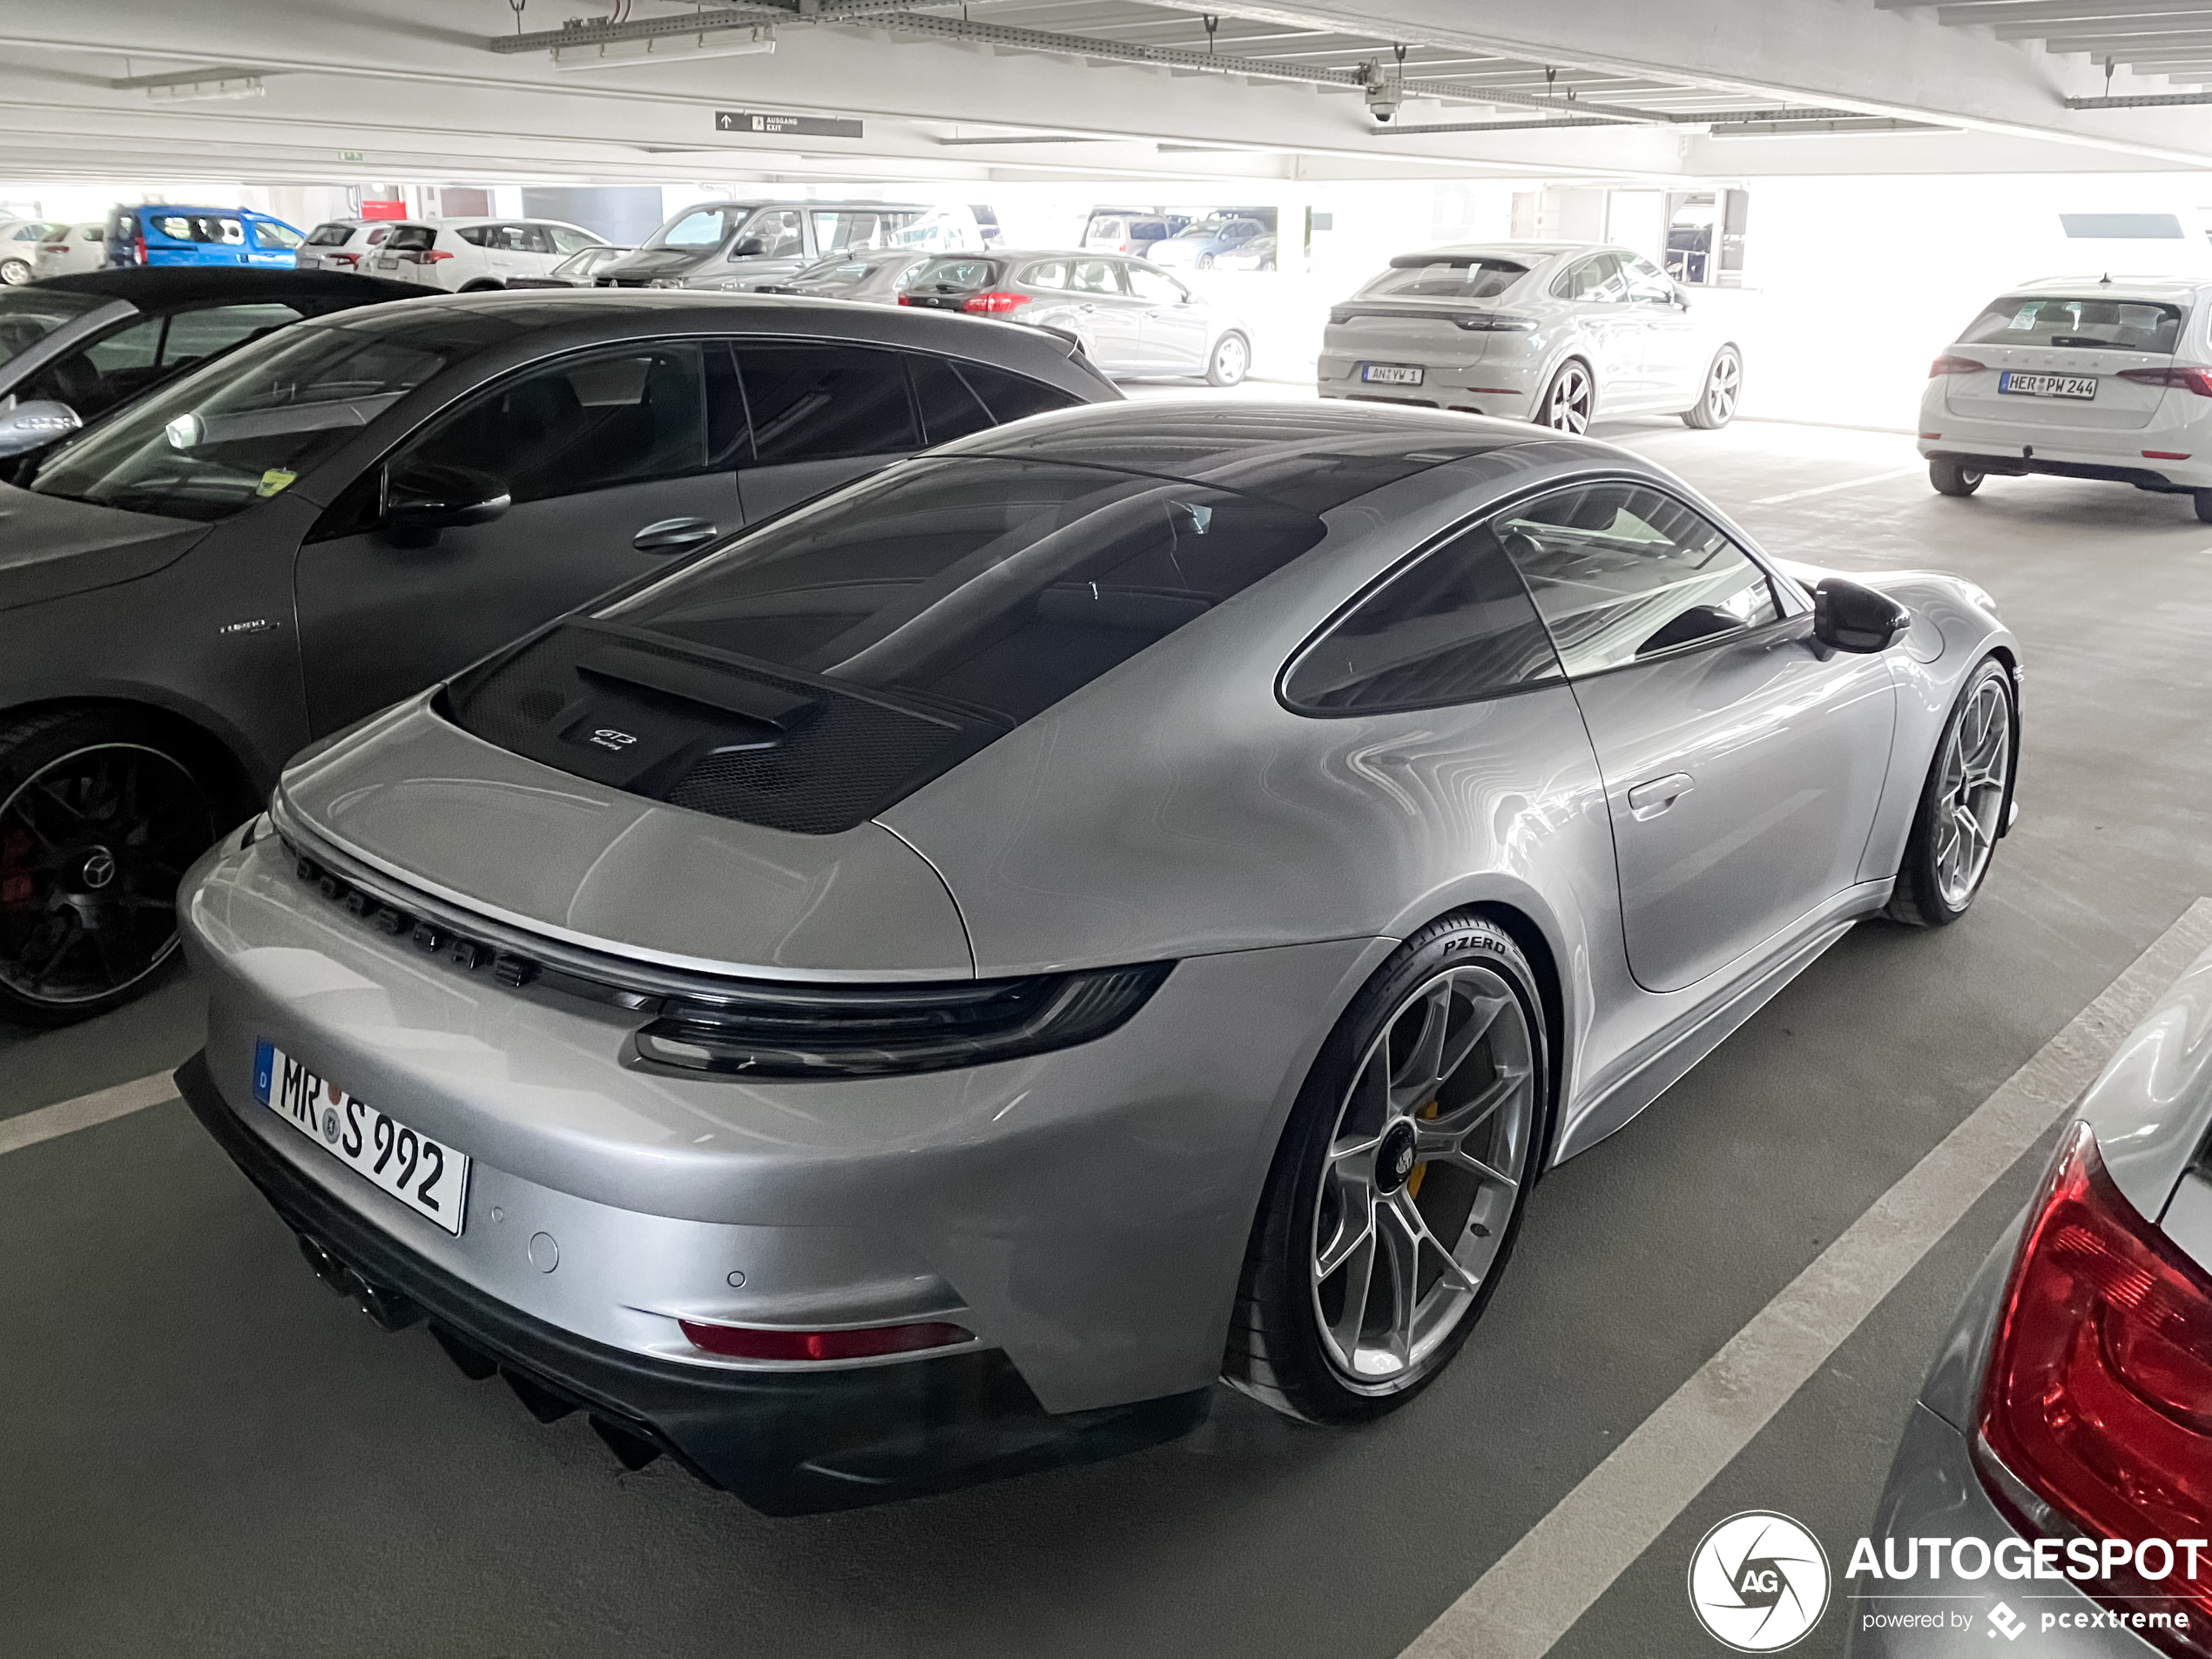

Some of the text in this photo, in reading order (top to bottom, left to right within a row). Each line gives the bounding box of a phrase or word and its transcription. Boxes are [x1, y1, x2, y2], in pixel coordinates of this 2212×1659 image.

[766, 117, 798, 125] AUSGANG
[1372, 368, 1386, 380] AN
[1393, 369, 1406, 381] YW
[1410, 370, 1416, 381] 1
[2009, 375, 2037, 390] HER
[2046, 378, 2066, 393] PW
[2067, 380, 2094, 395] 244
[595, 729, 637, 744] GT3
[260, 1072, 267, 1089] D
[280, 1055, 444, 1212] MR S 992
